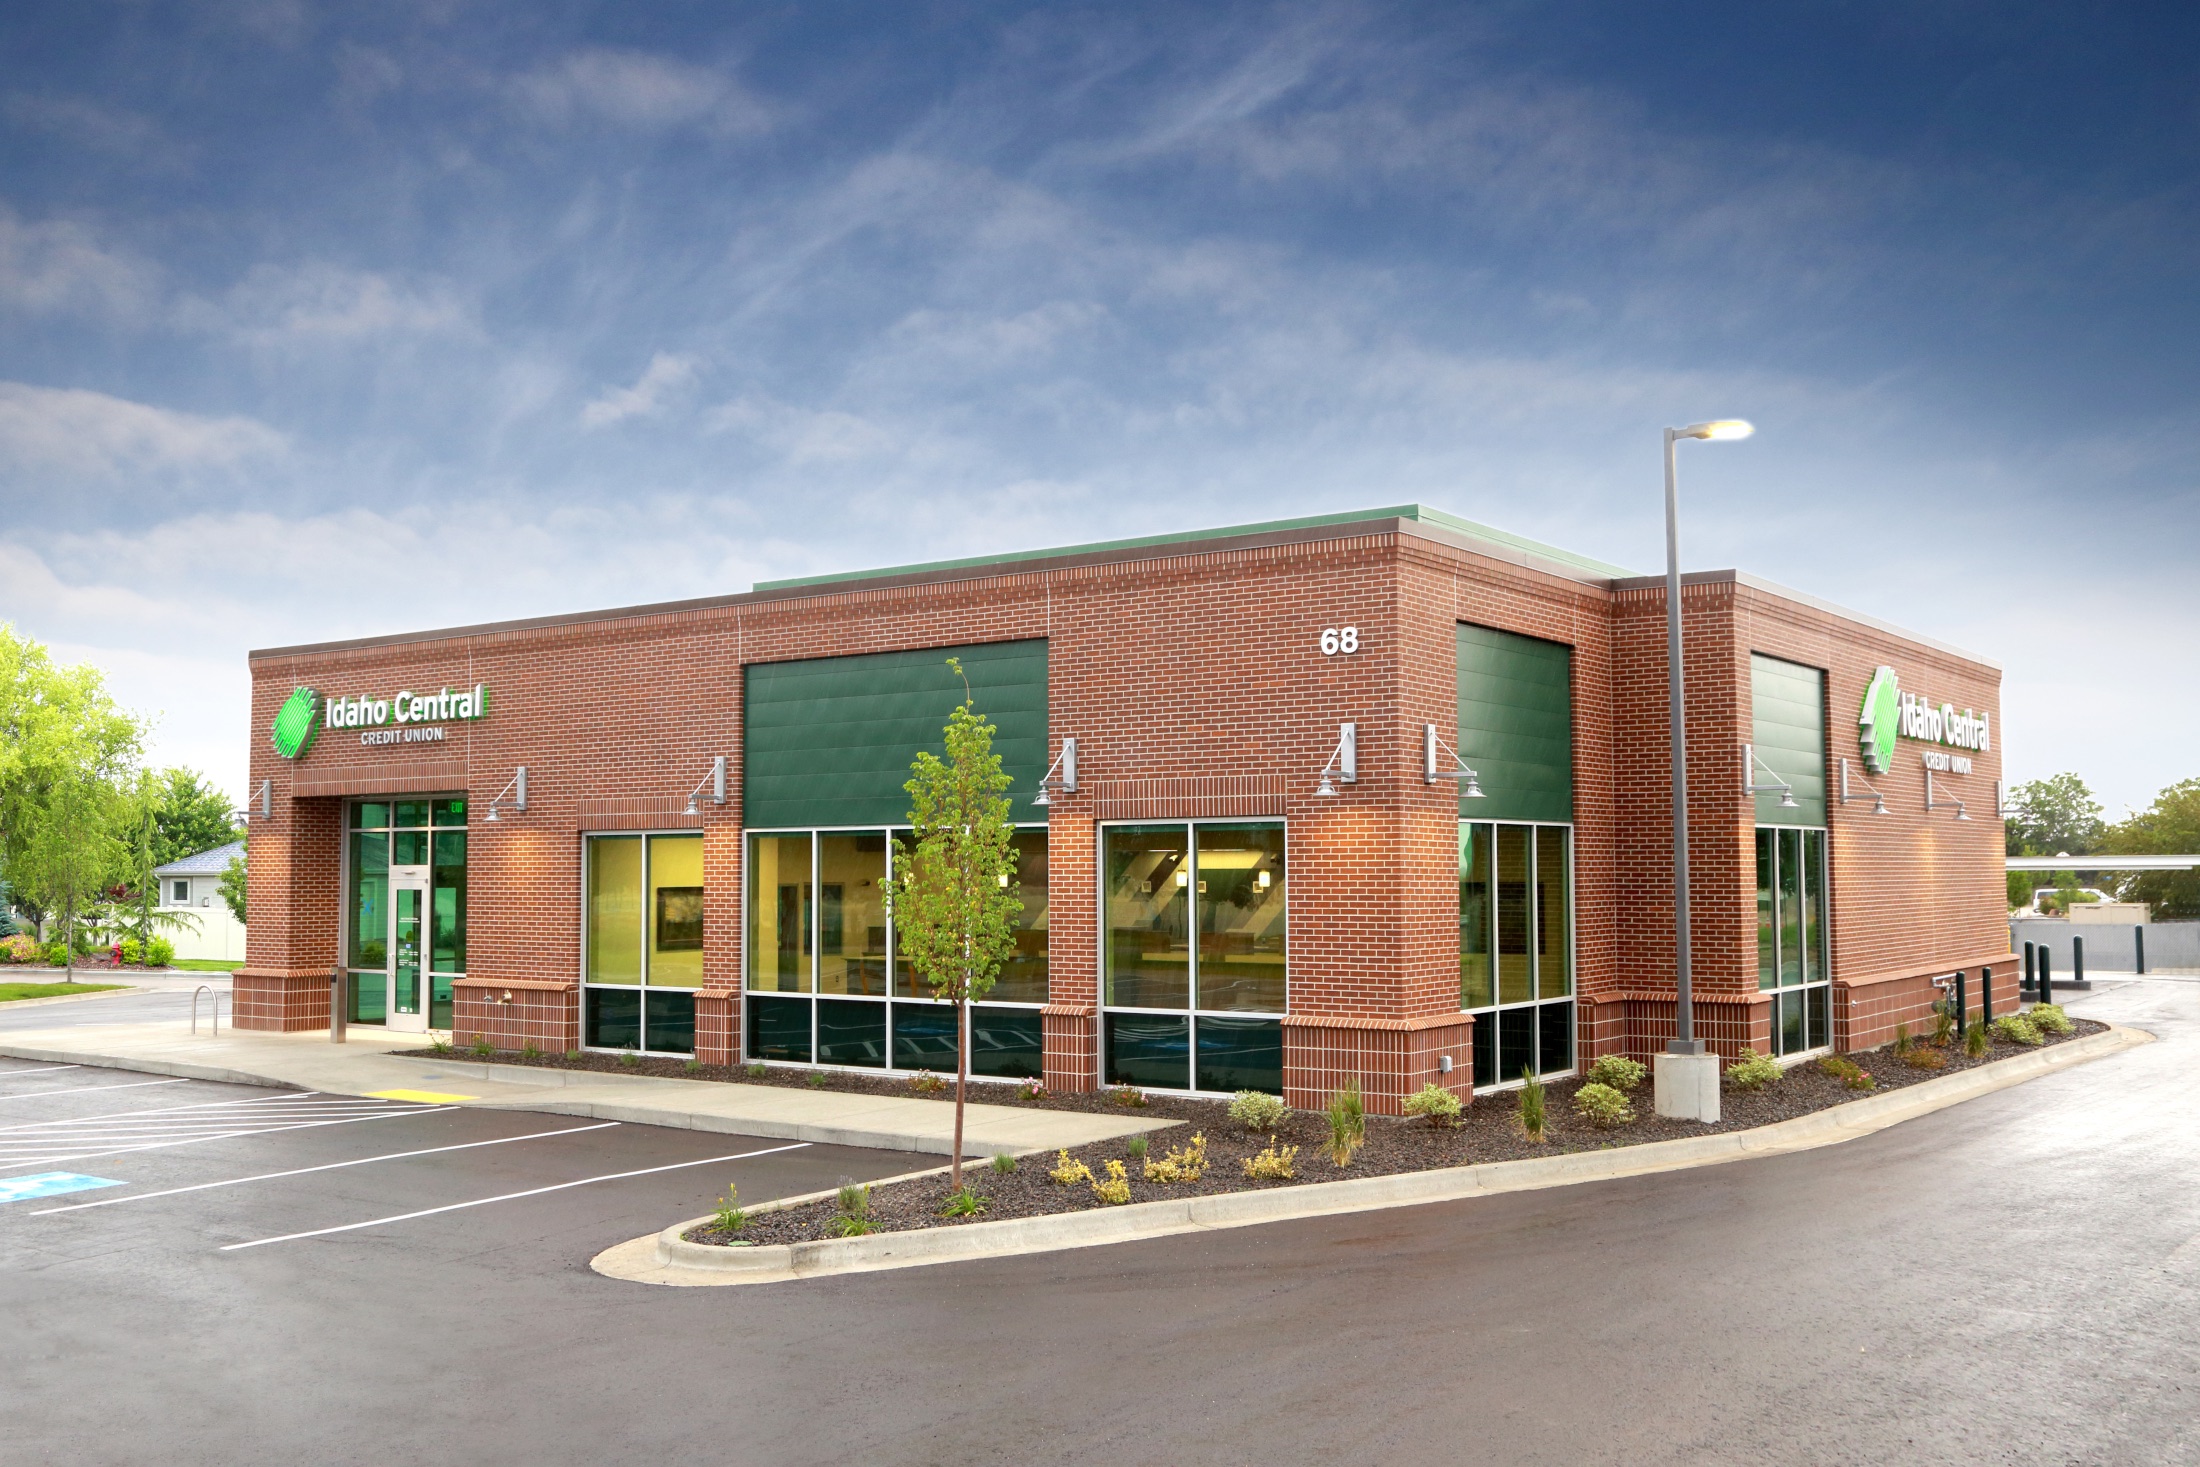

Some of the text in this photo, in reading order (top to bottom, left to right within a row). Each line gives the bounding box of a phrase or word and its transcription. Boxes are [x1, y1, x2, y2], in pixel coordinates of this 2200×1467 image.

[1320, 626, 1359, 655] 68
[326, 683, 484, 728] Idaho Central
[1901, 691, 1990, 752] Idaho Central
[361, 727, 443, 746] CREDIT UNION
[1925, 751, 1972, 775] CREDIT UNION
